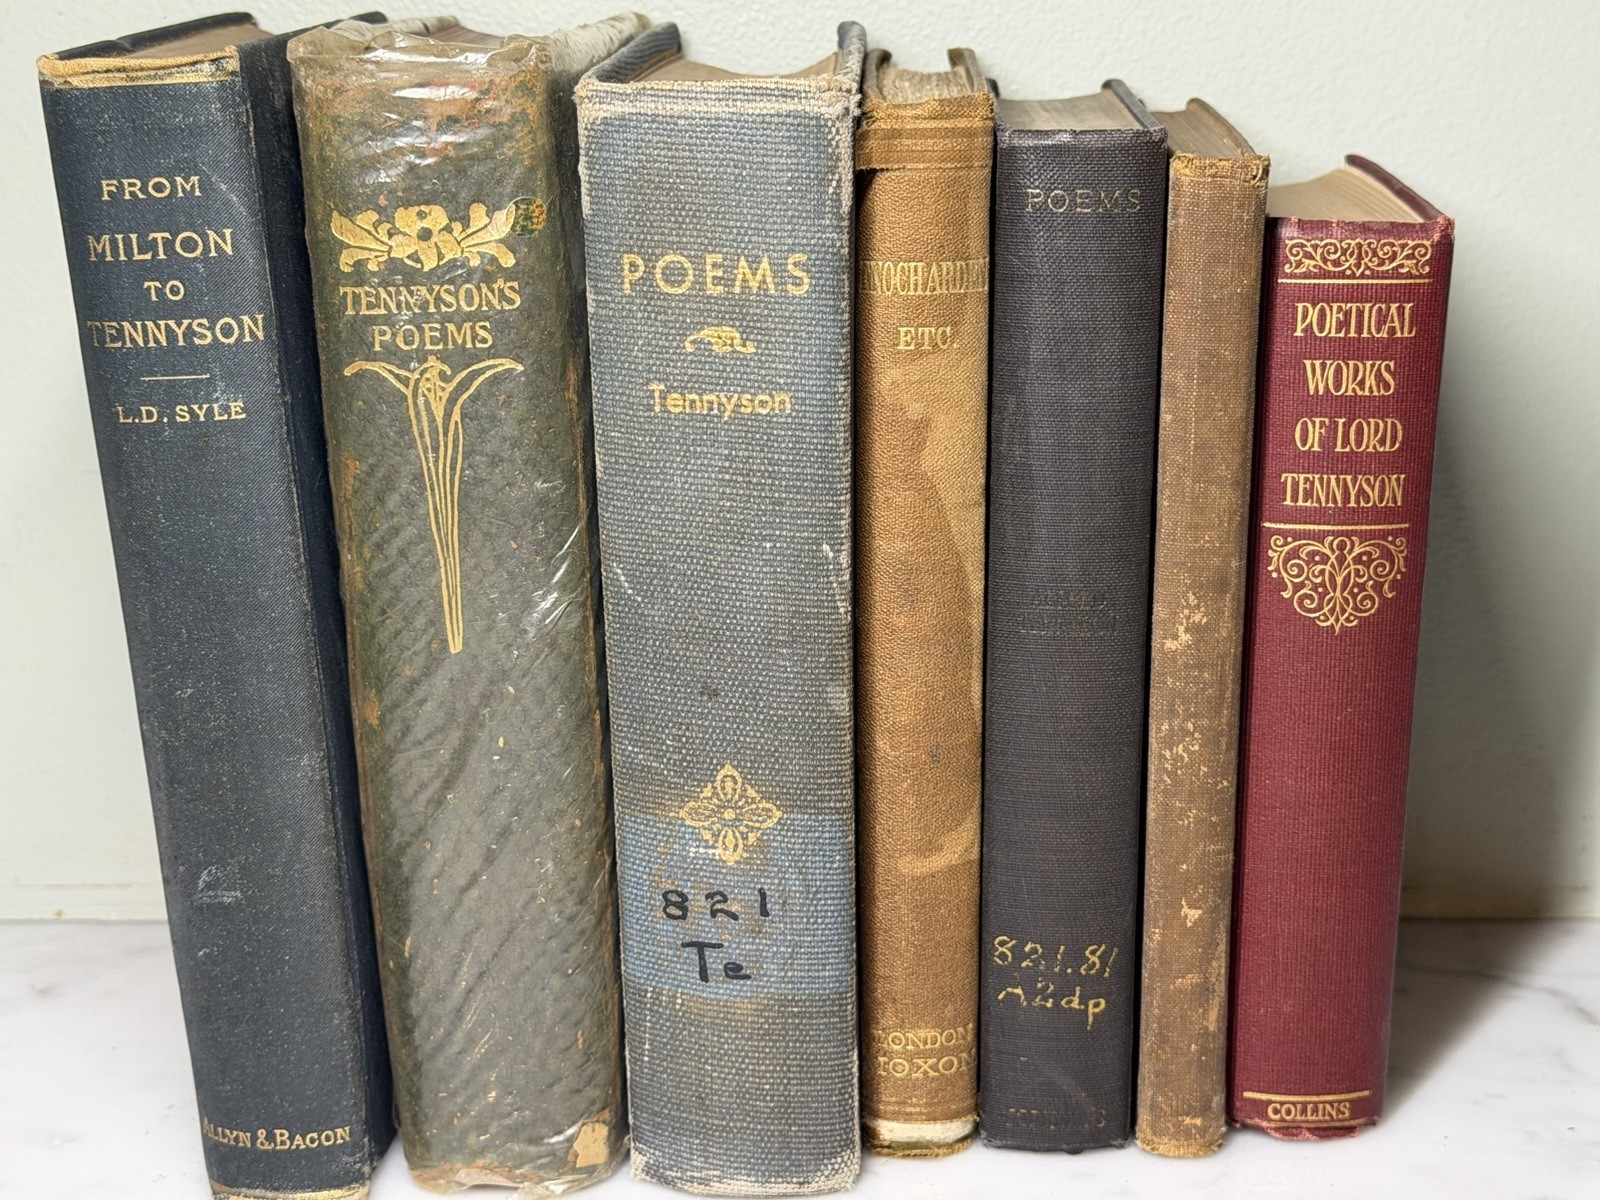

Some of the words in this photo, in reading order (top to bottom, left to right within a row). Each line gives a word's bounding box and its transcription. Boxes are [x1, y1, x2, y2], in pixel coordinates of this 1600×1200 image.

[101, 176, 202, 201] FROM
[1025, 188, 1141, 213] POEMS
[87, 228, 234, 261] MILTON
[144, 280, 185, 301] TO
[622, 252, 811, 295] POEMS
[340, 278, 521, 316] TENNYSON'S
[87, 314, 266, 348] TENNYSON
[372, 321, 494, 351] POEMS
[1293, 302, 1417, 338] POETICAL
[896, 326, 958, 350] ETC.
[1303, 359, 1396, 396] WORKS
[116, 405, 168, 424] L.D.
[175, 401, 247, 423] SYLE
[647, 381, 792, 422] Tennyson
[1294, 417, 1330, 452] OF
[1334, 418, 1403, 452] LORD
[1280, 473, 1406, 507] TENNYSON
[662, 887, 770, 921] 821
[681, 941, 752, 984] Te
[993, 935, 1119, 978] 821.81
[1267, 1102, 1350, 1121] COLLINS
[202, 1116, 251, 1148] ALLYN
